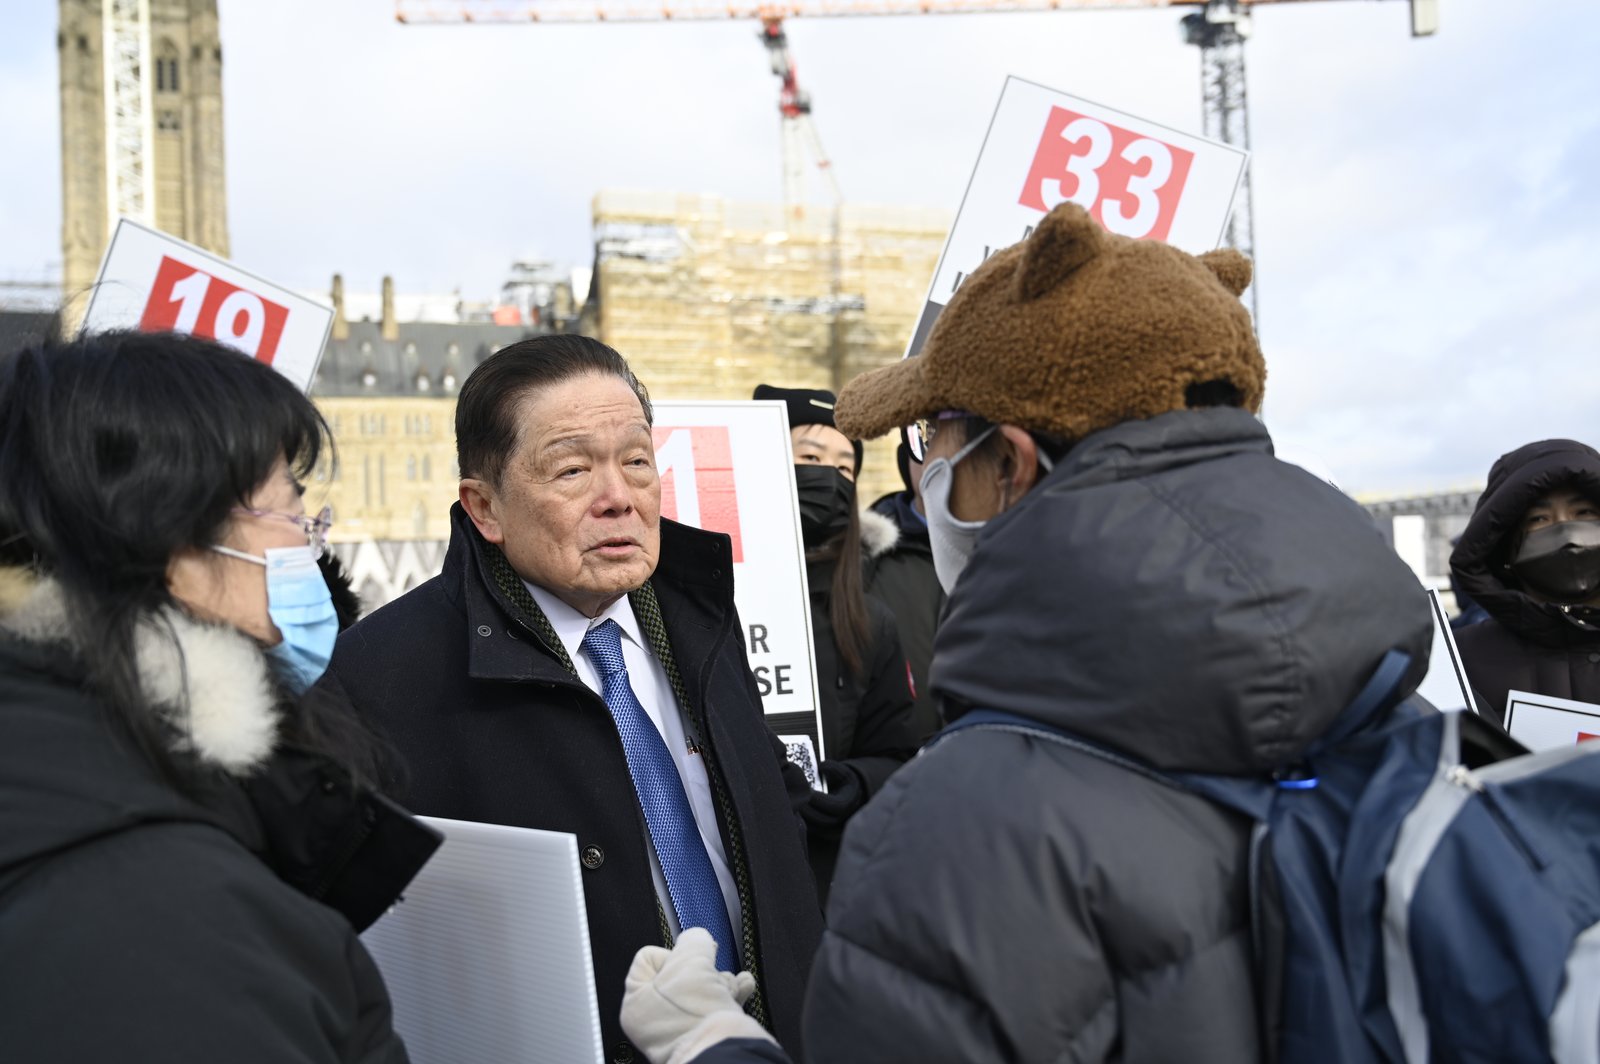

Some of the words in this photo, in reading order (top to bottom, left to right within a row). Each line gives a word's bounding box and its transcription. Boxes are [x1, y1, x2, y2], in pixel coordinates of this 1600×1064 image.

[1040, 117, 1173, 239] 33
[169, 269, 266, 357] 19
[753, 665, 794, 697] SE
